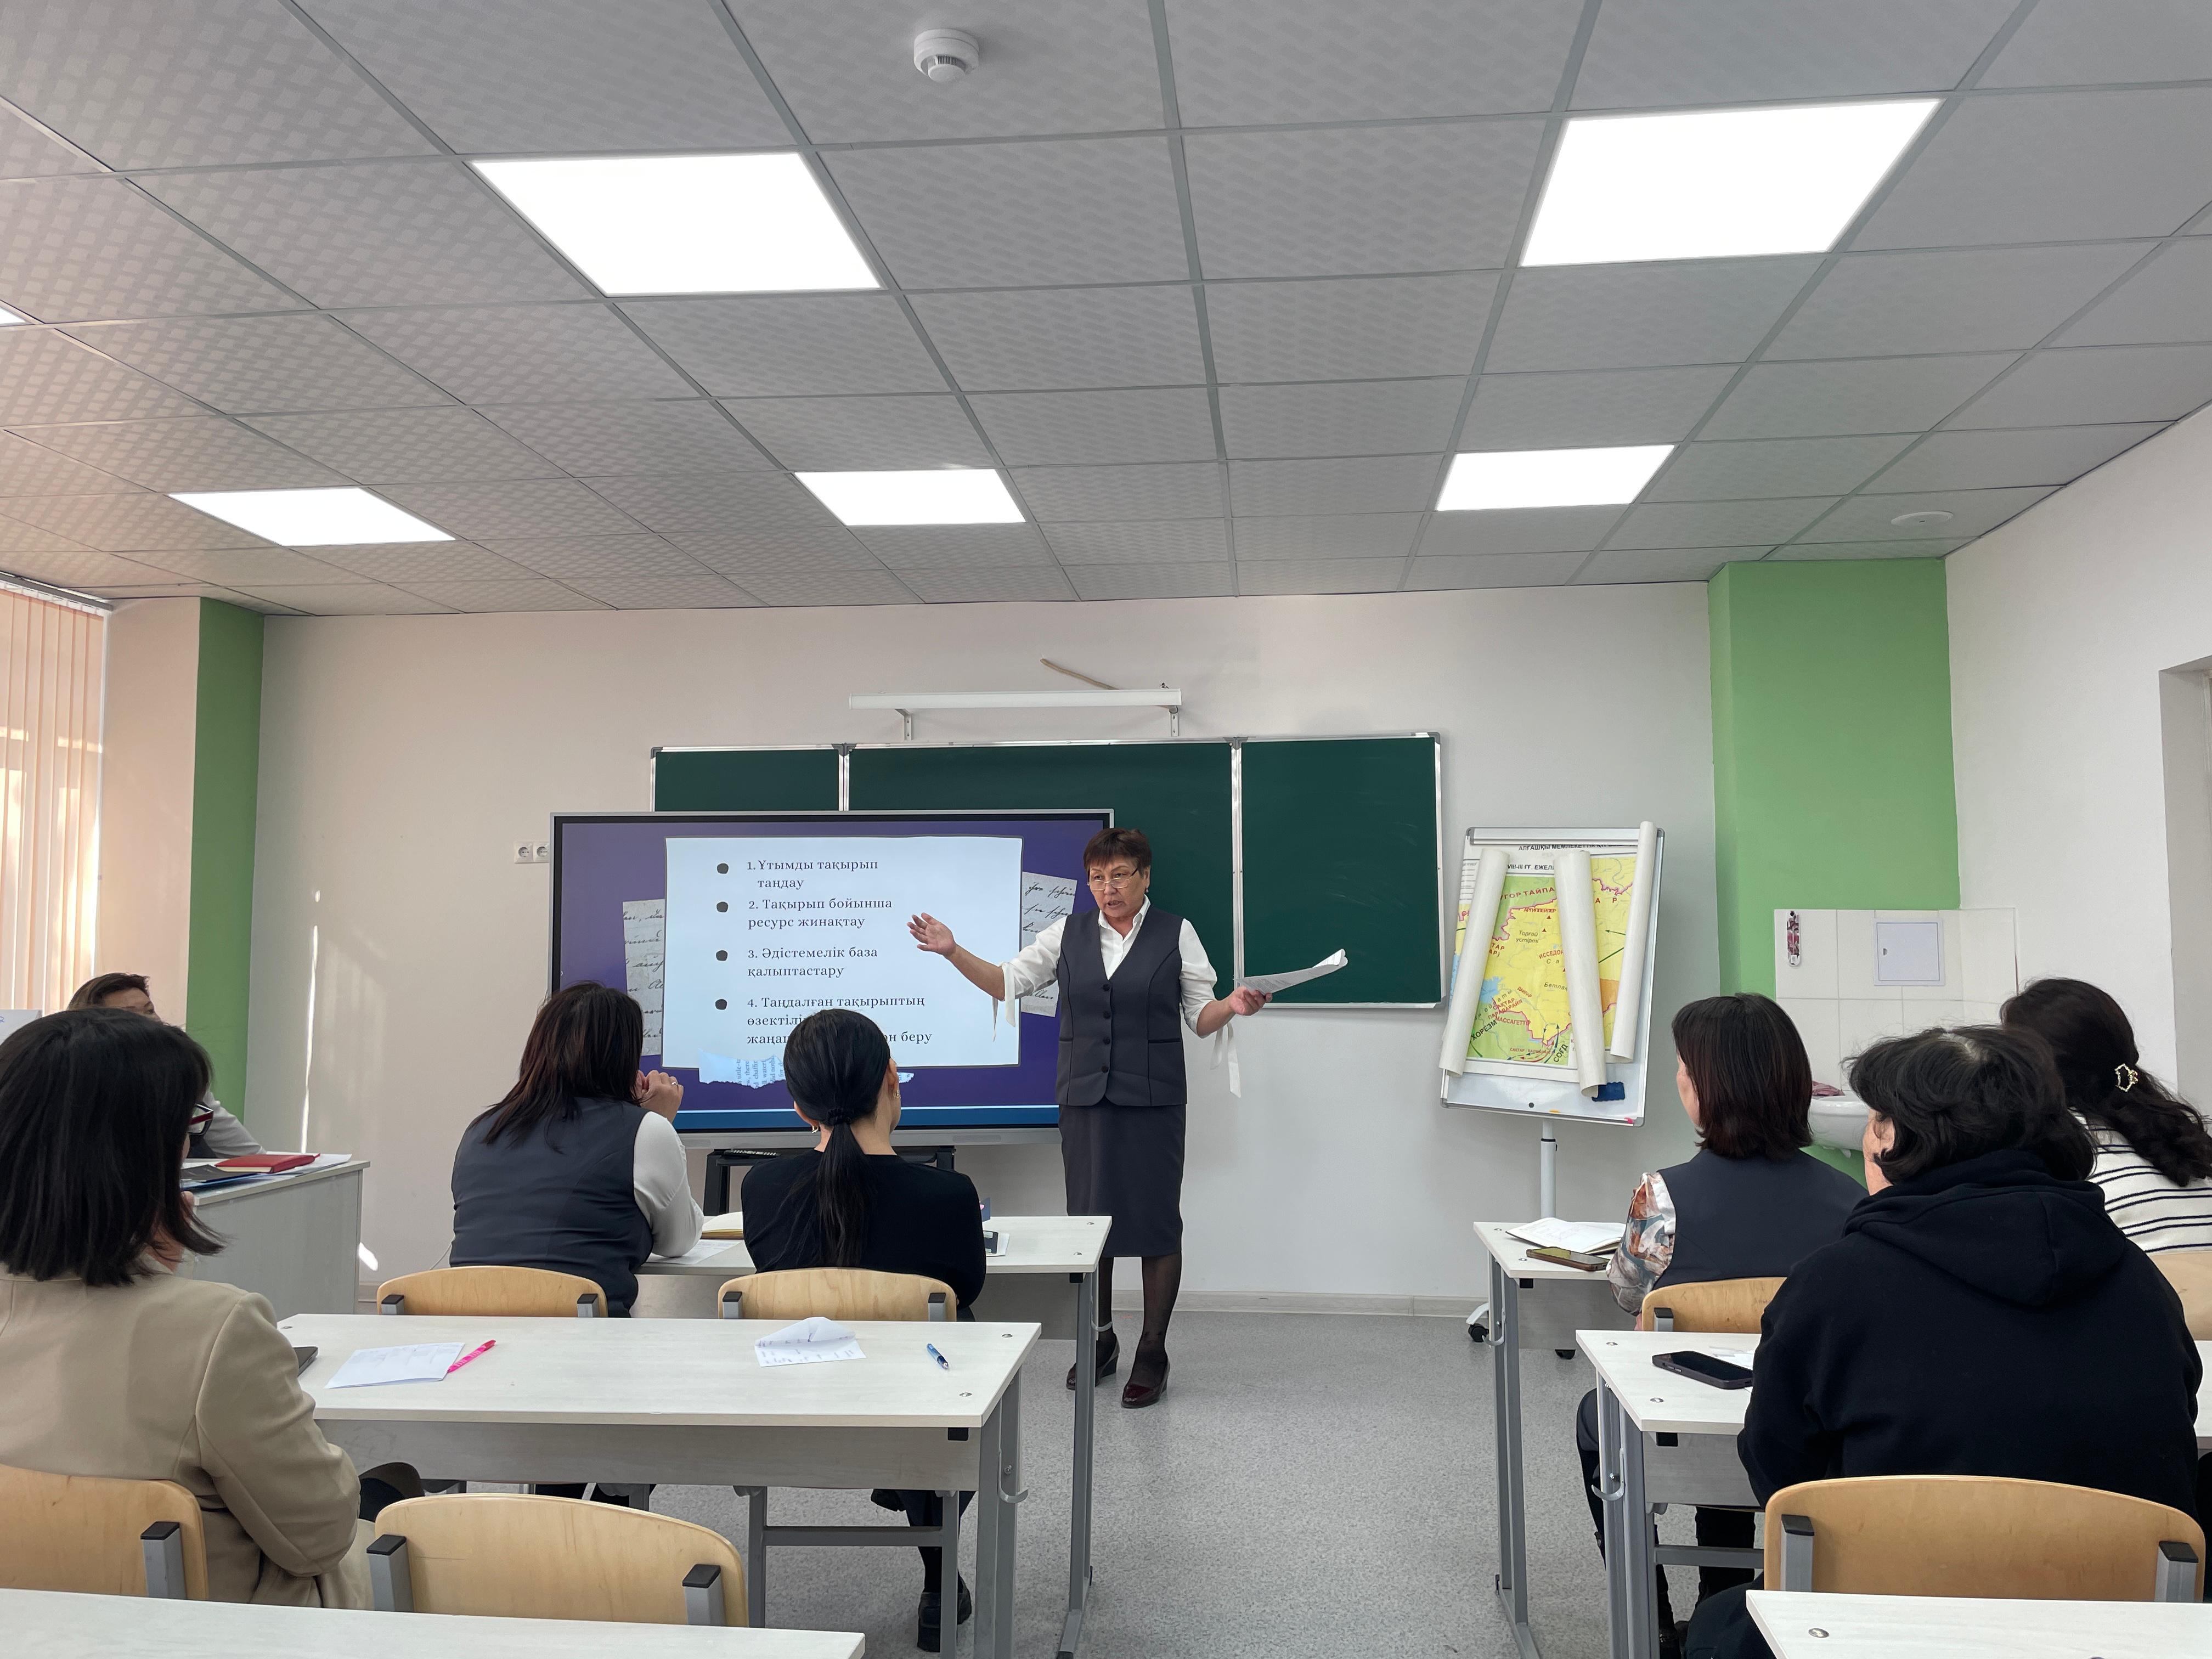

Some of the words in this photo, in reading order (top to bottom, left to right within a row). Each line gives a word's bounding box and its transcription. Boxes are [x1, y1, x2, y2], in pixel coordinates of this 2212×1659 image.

[747, 862, 756, 870] 1.
[758, 860, 814, 871] Ұтымды
[817, 861, 878, 872] тақырып
[758, 879, 804, 890] таңдау
[748, 901, 758, 909] 2.
[763, 899, 825, 911] Тақырып
[829, 898, 893, 909] бойынша
[748, 919, 794, 929] ресурс
[798, 918, 865, 928] жинақтау
[748, 950, 758, 958] 3.
[762, 946, 845, 960] Әдістемелік
[849, 946, 877, 957] база
[748, 968, 844, 978] қалыптастару
[761, 997, 833, 1008] Таңдалған
[837, 997, 925, 1009] тақырыптың
[1471, 1019, 1498, 1041] ХОРЕЗМ
[901, 1031, 932, 1044] беру
